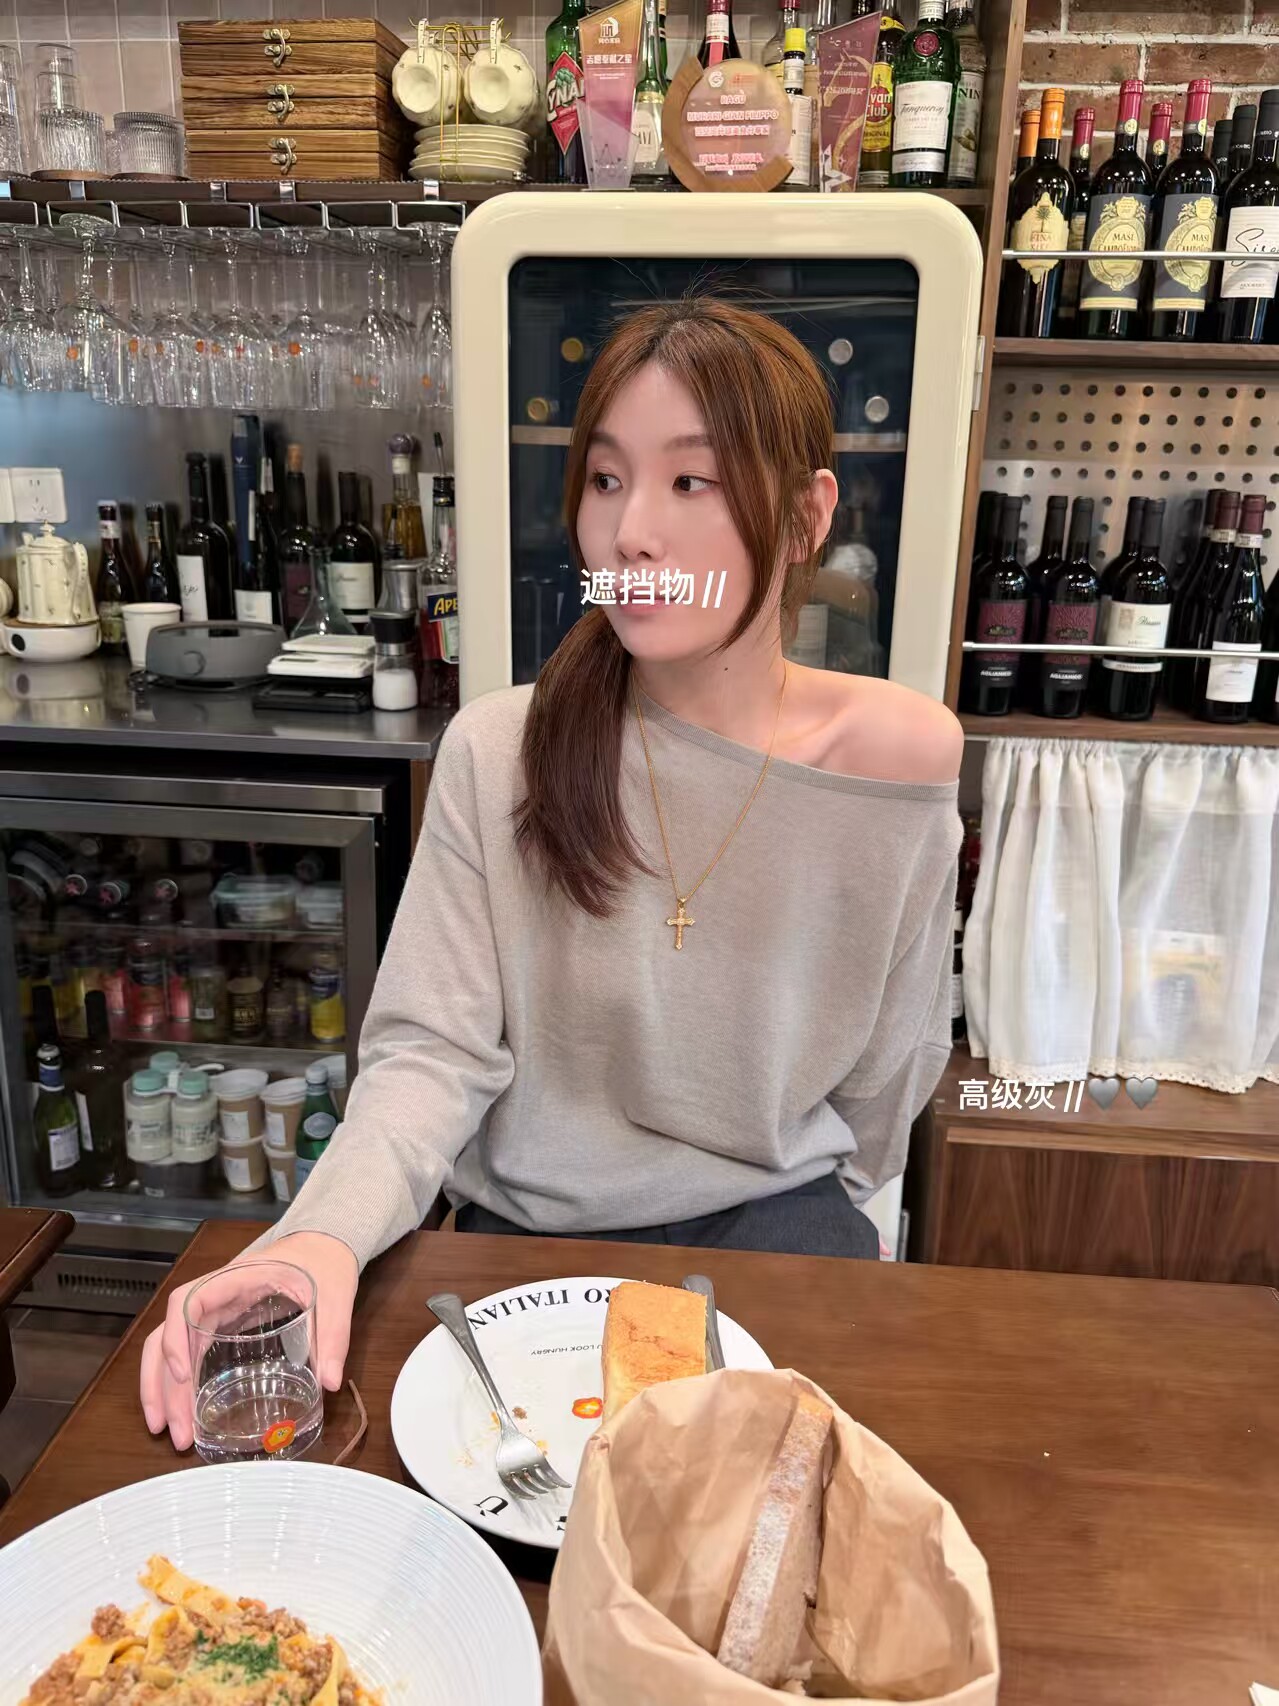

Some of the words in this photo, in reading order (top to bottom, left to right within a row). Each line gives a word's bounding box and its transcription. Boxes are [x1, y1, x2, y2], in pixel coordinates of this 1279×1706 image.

[1112, 232, 1135, 242] MASI
[467, 1288, 571, 1331] ITALIAN
[530, 1347, 568, 1356] HUNGRY
[570, 1344, 595, 1352] LOOK
